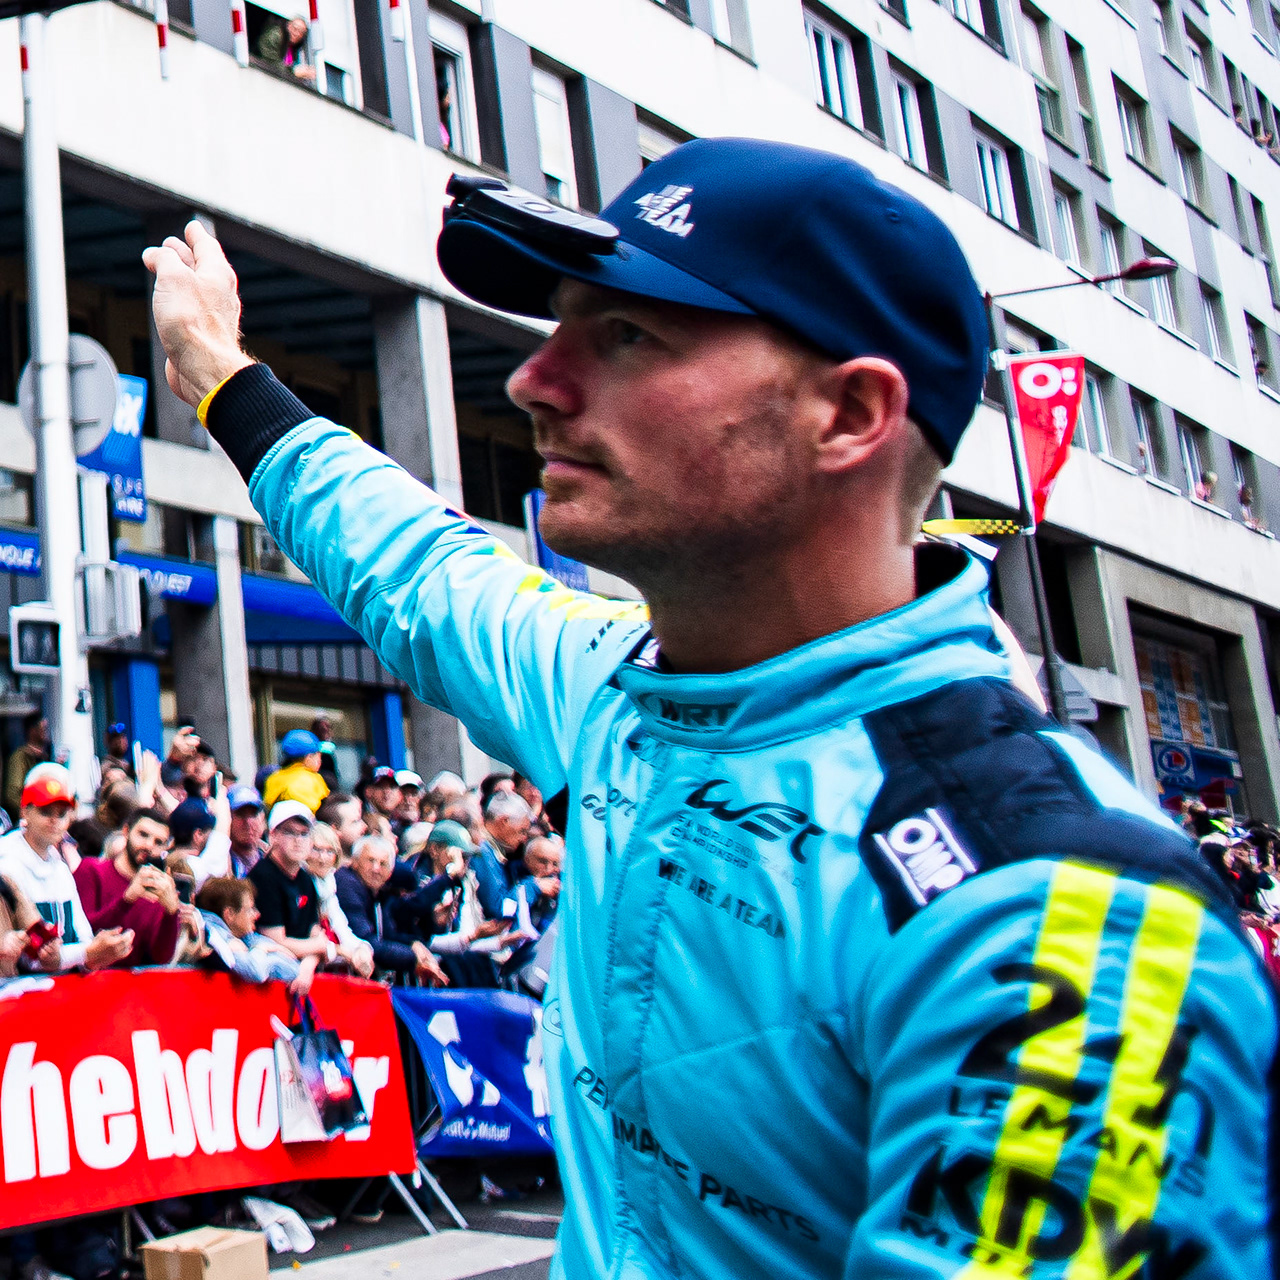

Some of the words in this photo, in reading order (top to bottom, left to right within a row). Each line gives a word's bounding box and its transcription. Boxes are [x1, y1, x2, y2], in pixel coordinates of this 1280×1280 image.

[658, 697, 739, 728] WRT
[888, 817, 964, 891] OMP
[658, 856, 688, 888] WE
[948, 1086, 1010, 1117] LE
[700, 1173, 821, 1243] PARTS
